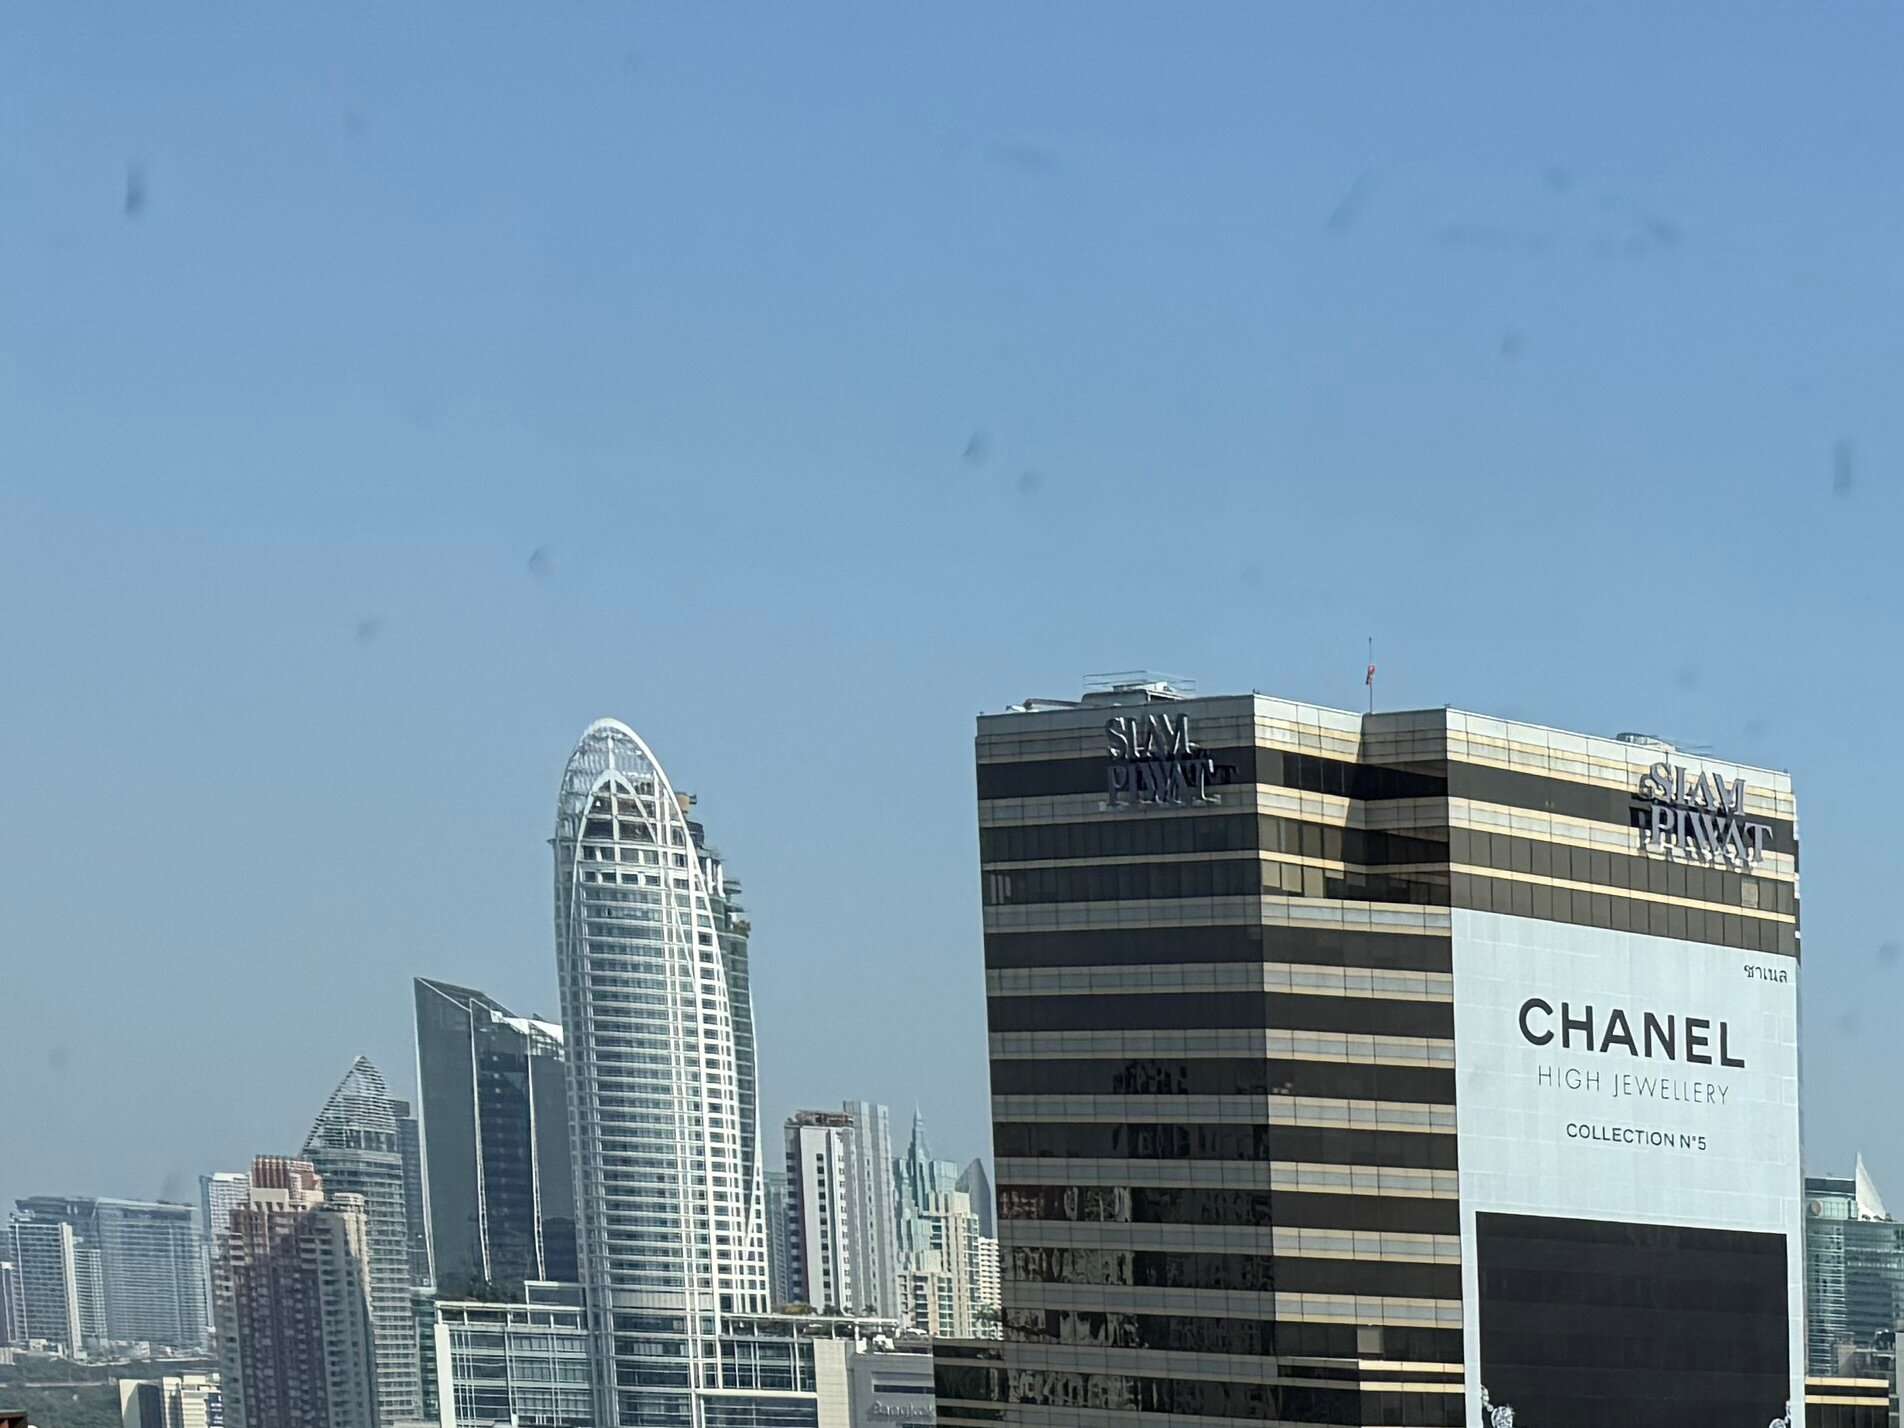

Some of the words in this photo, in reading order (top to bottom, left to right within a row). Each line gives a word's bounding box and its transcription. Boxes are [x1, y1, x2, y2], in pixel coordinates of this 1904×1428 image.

[1105, 713, 1195, 760] SIAM
[1650, 762, 1746, 816] SIAM
[1651, 804, 1773, 864] PIWAT
[1743, 964, 1788, 983] ชาเนล
[1519, 998, 1745, 1068] CHANEL
[1538, 1066, 1600, 1092] HIGH
[1613, 1073, 1729, 1105] JEWELLERY
[1566, 1123, 1674, 1148] COLLECTION
